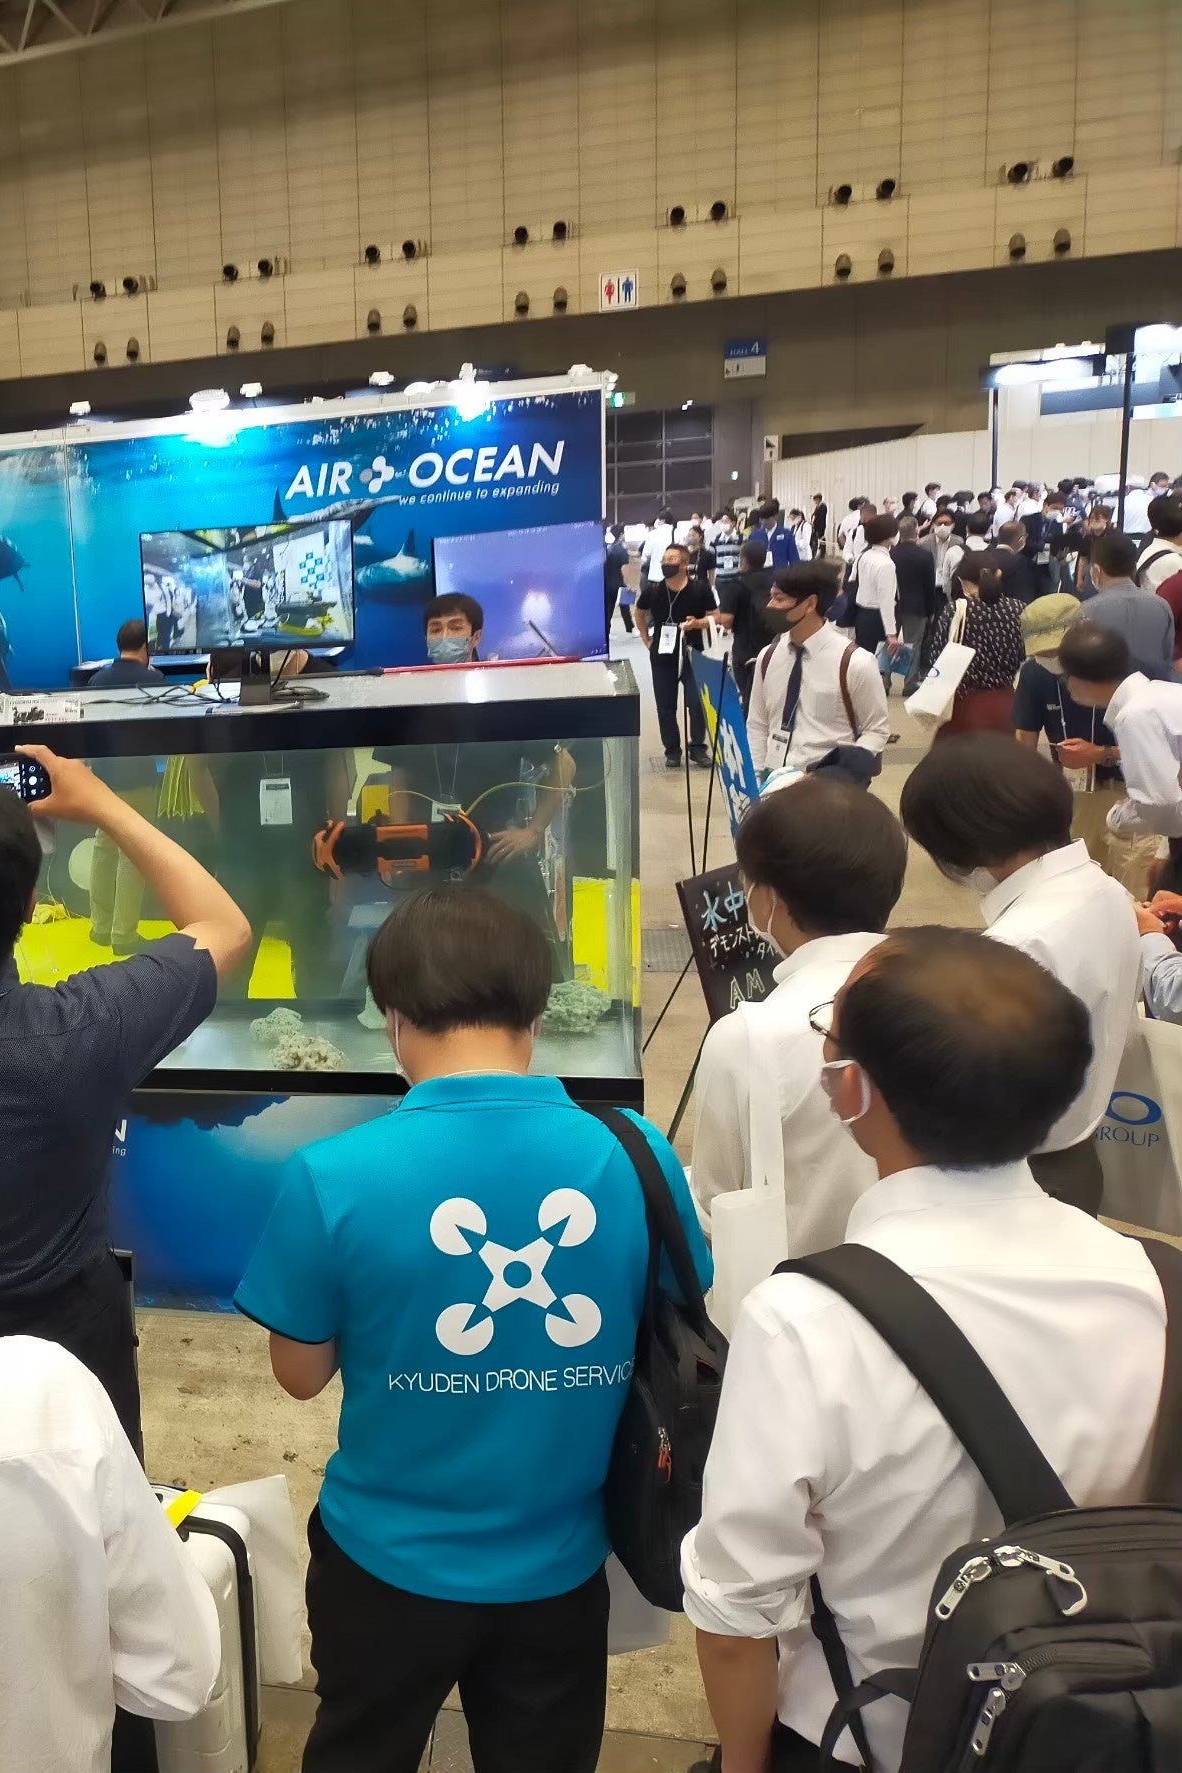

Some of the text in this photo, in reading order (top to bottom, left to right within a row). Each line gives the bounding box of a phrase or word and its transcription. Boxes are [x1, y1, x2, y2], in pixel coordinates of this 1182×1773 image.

[750, 341, 760, 355] 4
[285, 440, 565, 500] AIR OCEAN
[399, 481, 560, 506] we continue to expanding
[729, 967, 766, 1010] AM
[1094, 1125, 1160, 1148] ROUP
[388, 1372, 480, 1394] KYUDEN
[485, 1368, 558, 1392] DRONE
